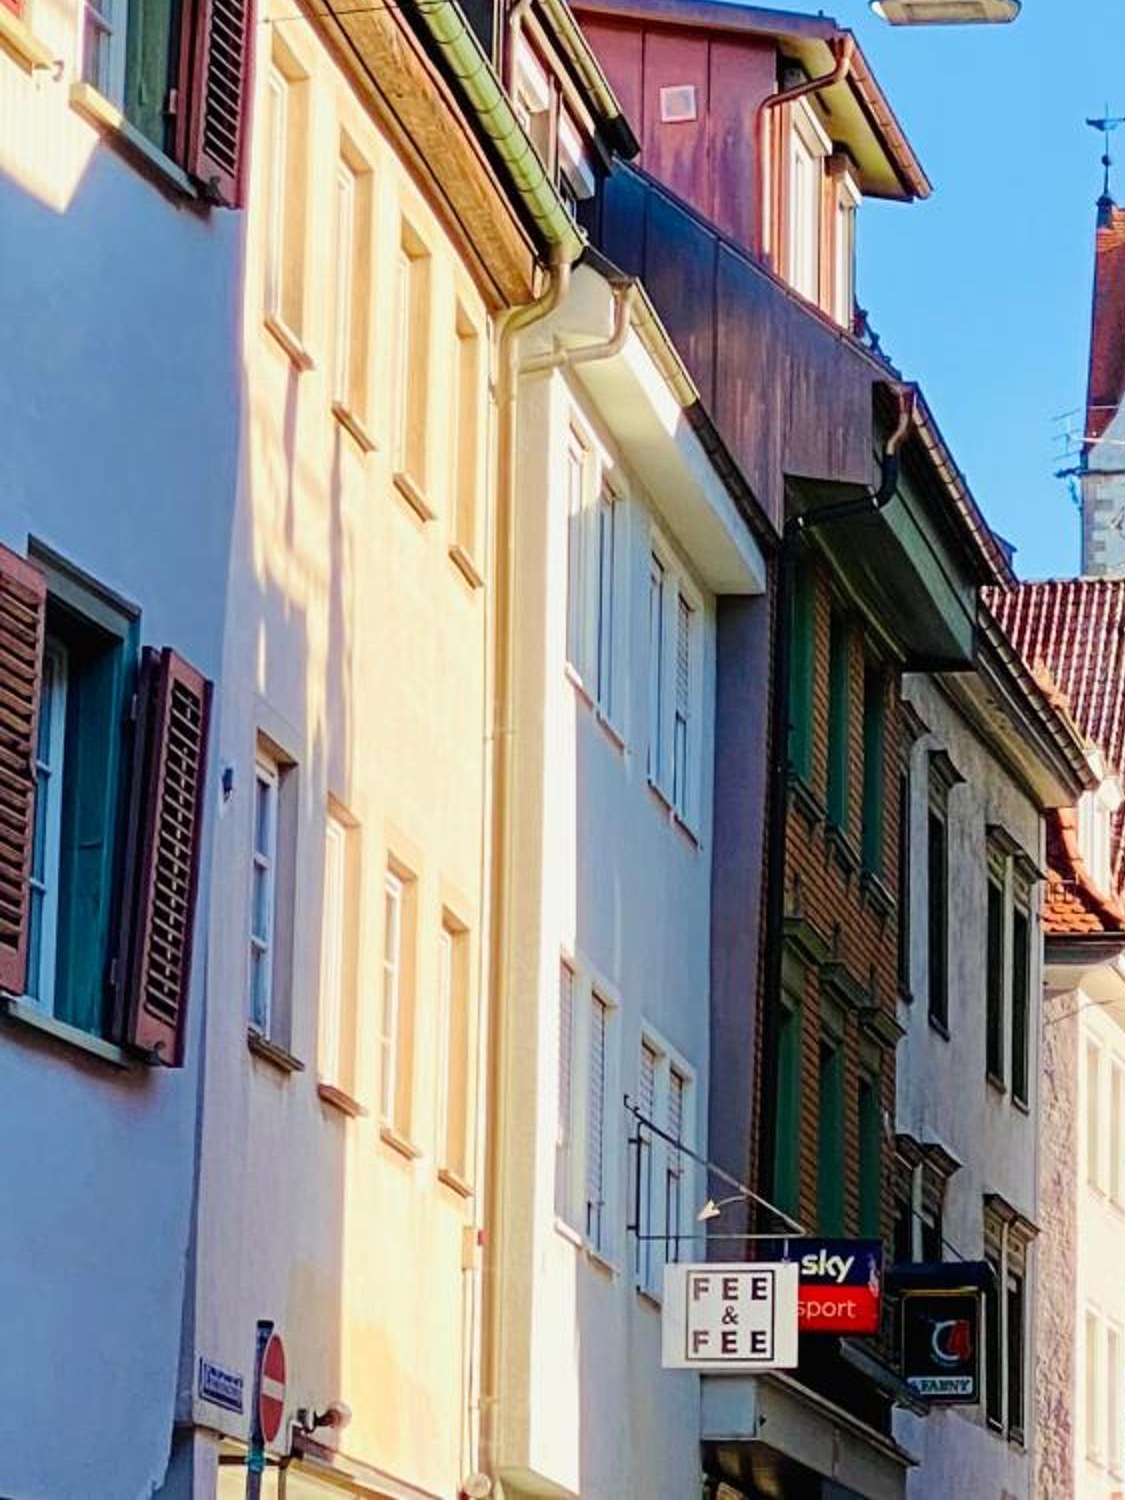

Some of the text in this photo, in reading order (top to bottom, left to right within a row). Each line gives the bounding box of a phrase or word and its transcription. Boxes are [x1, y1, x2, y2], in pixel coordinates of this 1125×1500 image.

[801, 1249, 854, 1283] sky
[693, 1277, 767, 1300] FEE
[721, 1305, 739, 1325] &
[795, 1301, 856, 1320] sport
[692, 1330, 767, 1354] FEE
